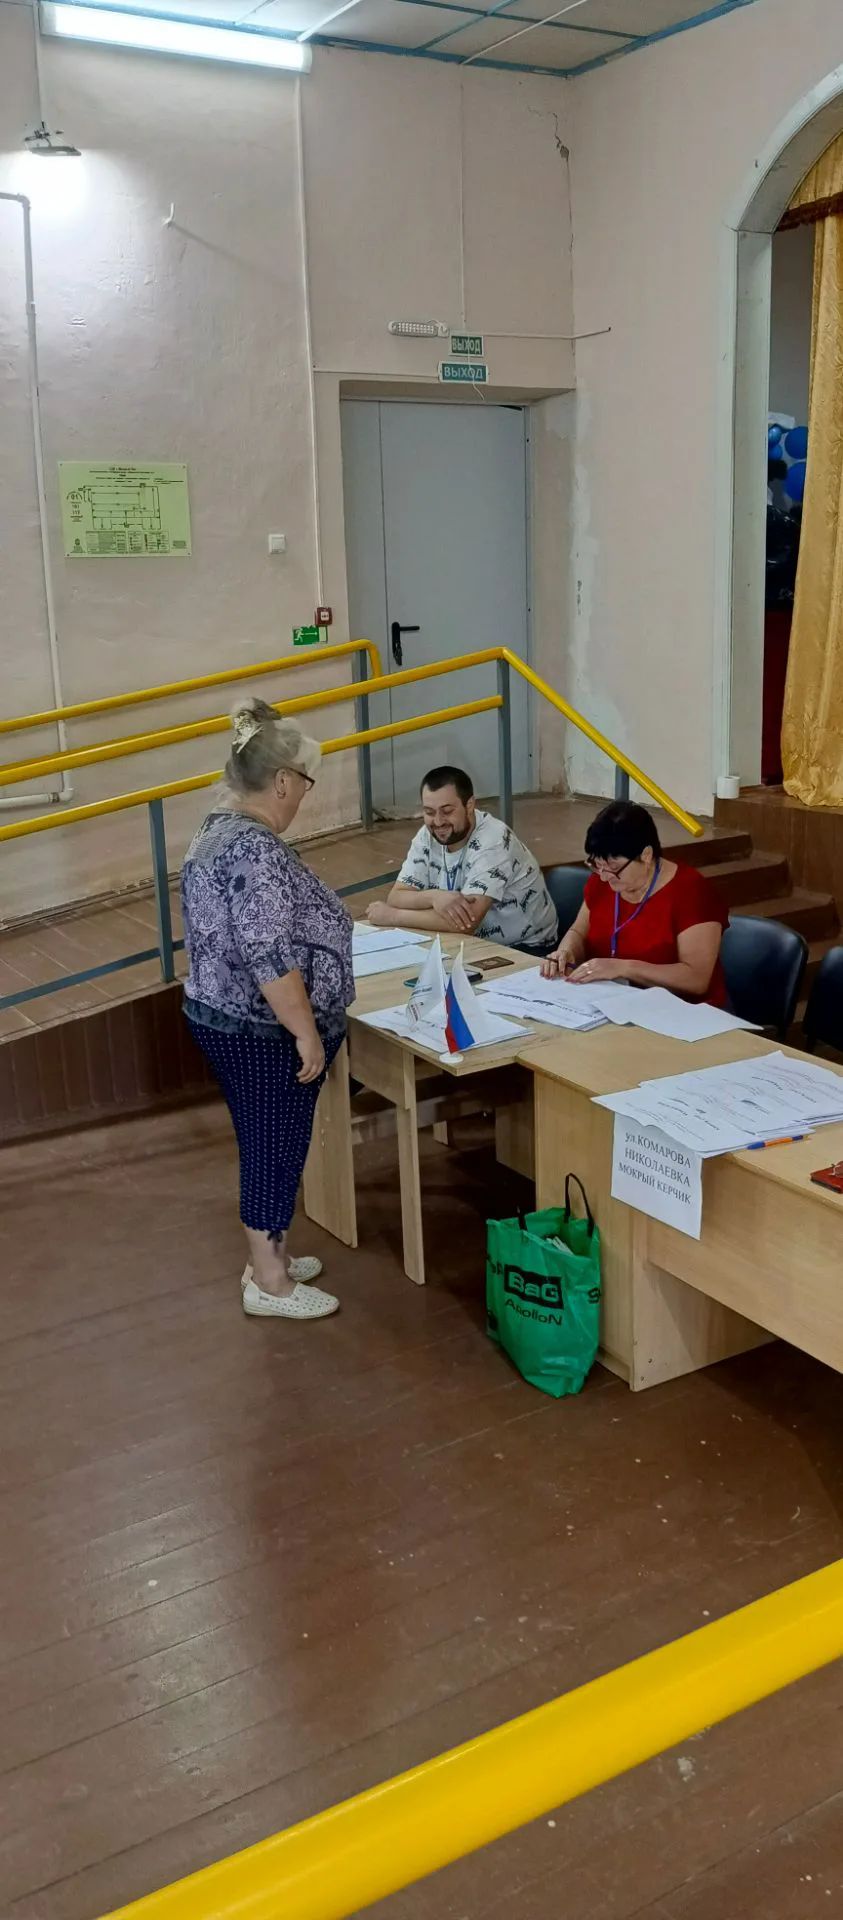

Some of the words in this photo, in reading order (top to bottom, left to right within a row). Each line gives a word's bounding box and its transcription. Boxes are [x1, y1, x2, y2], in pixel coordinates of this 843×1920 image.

[452, 338, 480, 353] ВЫХОД
[444, 367, 483, 379] ВЫХОД
[619, 1162, 655, 1187] МОКРЫЙ
[657, 1181, 691, 1204] КЕРЧИК
[625, 1147, 690, 1187] НИКОЛАЕВКА
[509, 1271, 559, 1303] BaG
